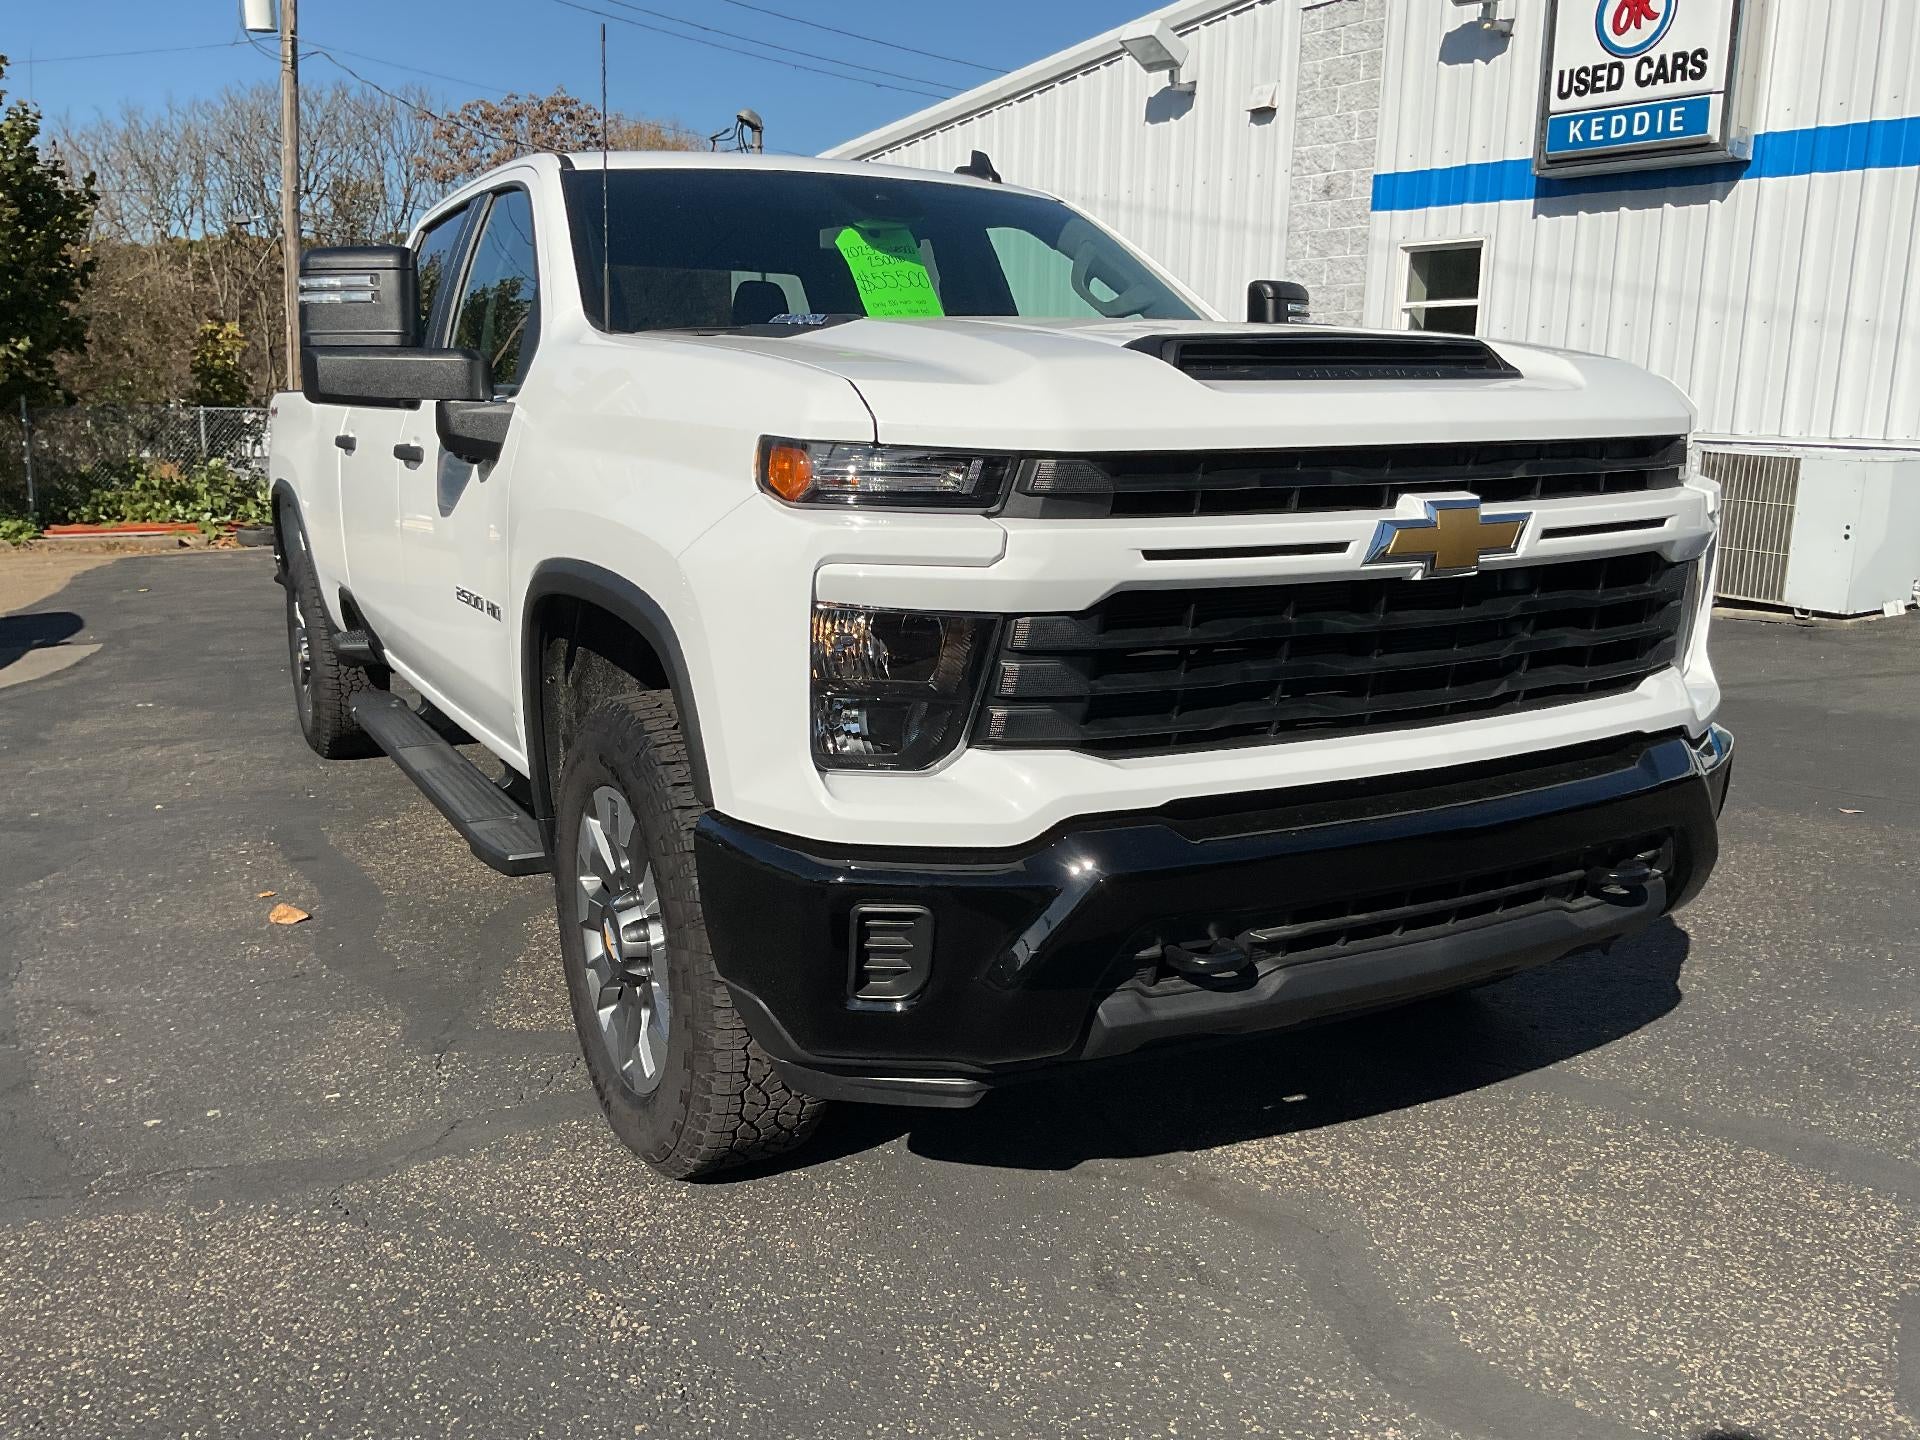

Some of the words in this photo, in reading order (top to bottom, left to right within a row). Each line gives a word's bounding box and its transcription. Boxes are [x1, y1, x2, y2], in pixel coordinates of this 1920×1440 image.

[1557, 60, 1625, 100] USED
[1634, 47, 1709, 88] CARS
[1568, 107, 1686, 143] KEDDIE
[455, 585, 485, 613] 2500
[486, 600, 501, 622] HD
